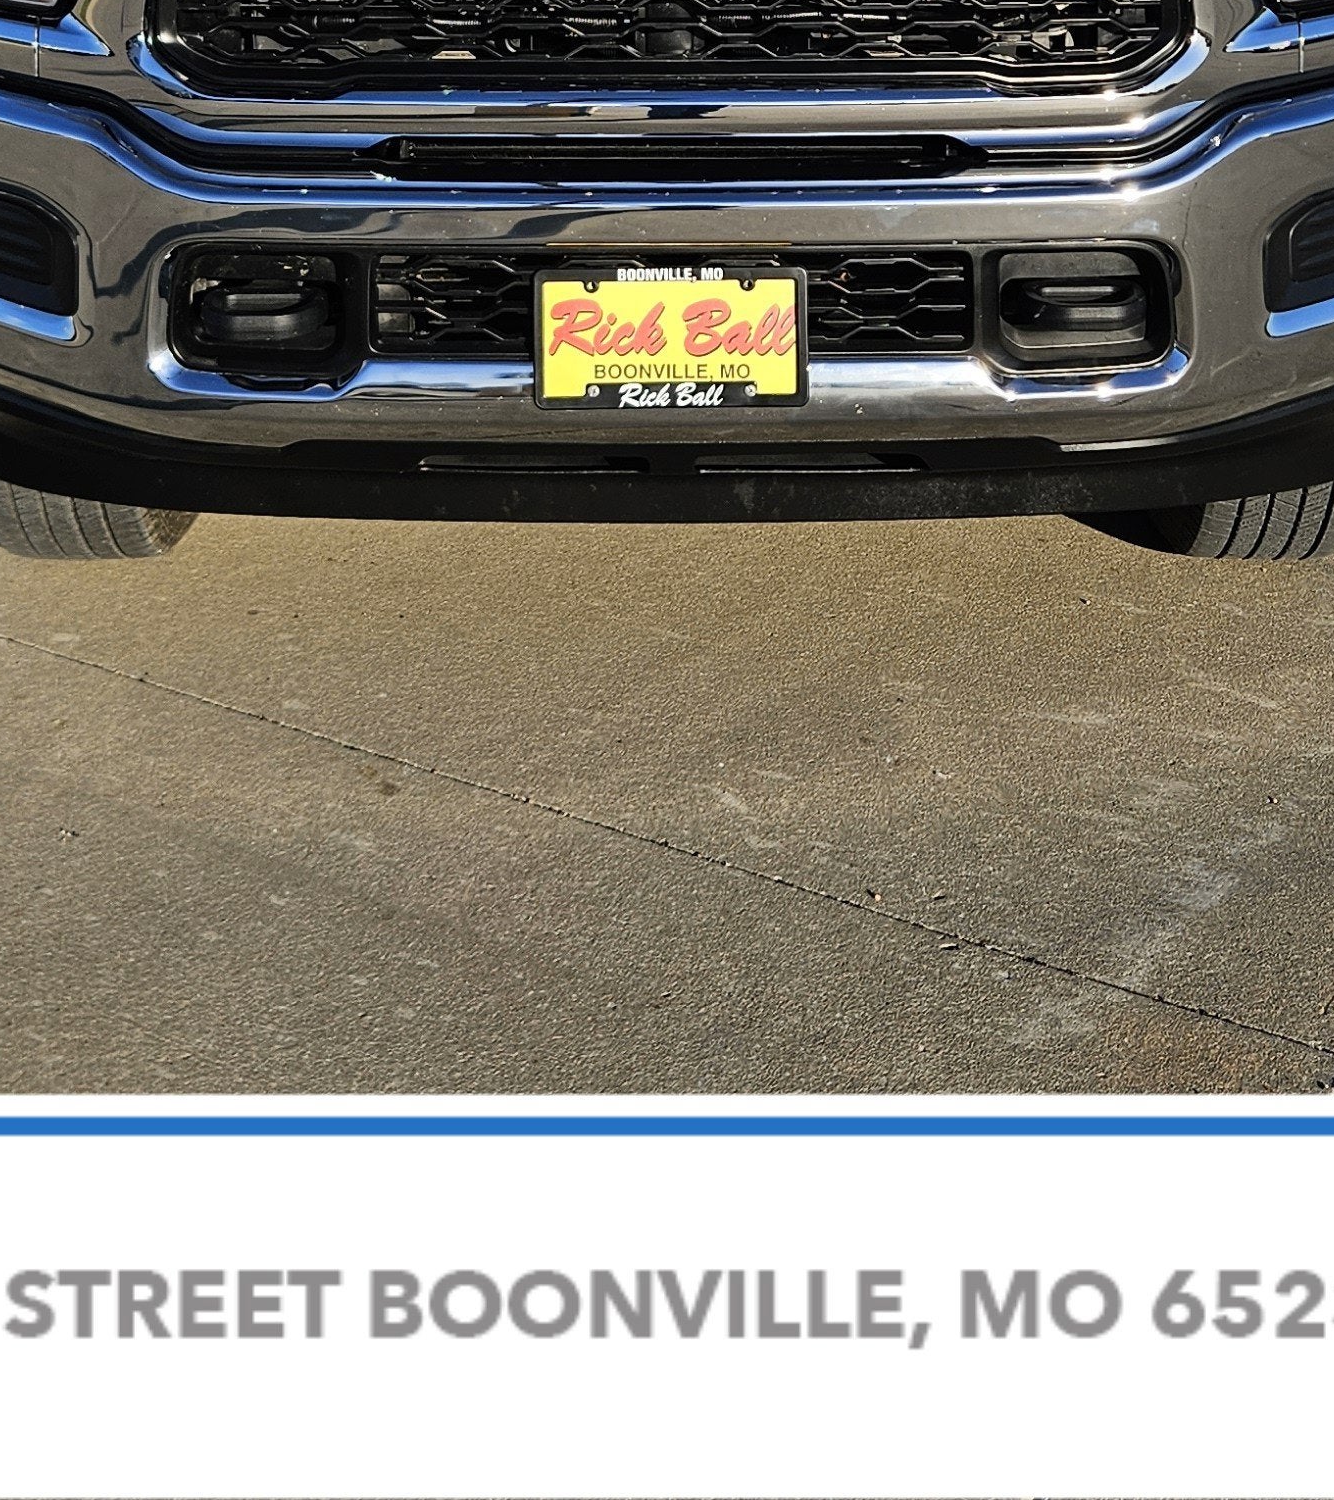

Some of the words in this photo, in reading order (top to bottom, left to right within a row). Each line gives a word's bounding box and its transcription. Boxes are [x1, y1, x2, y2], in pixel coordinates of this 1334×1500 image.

[617, 267, 696, 283] BOONVILLE,
[700, 267, 724, 281] MO
[548, 298, 668, 357] Rick
[682, 298, 797, 357] Ball
[594, 363, 714, 382] BOONVILLE,
[720, 363, 751, 379] MO
[618, 382, 672, 408] Rick
[675, 383, 724, 407] Ball
